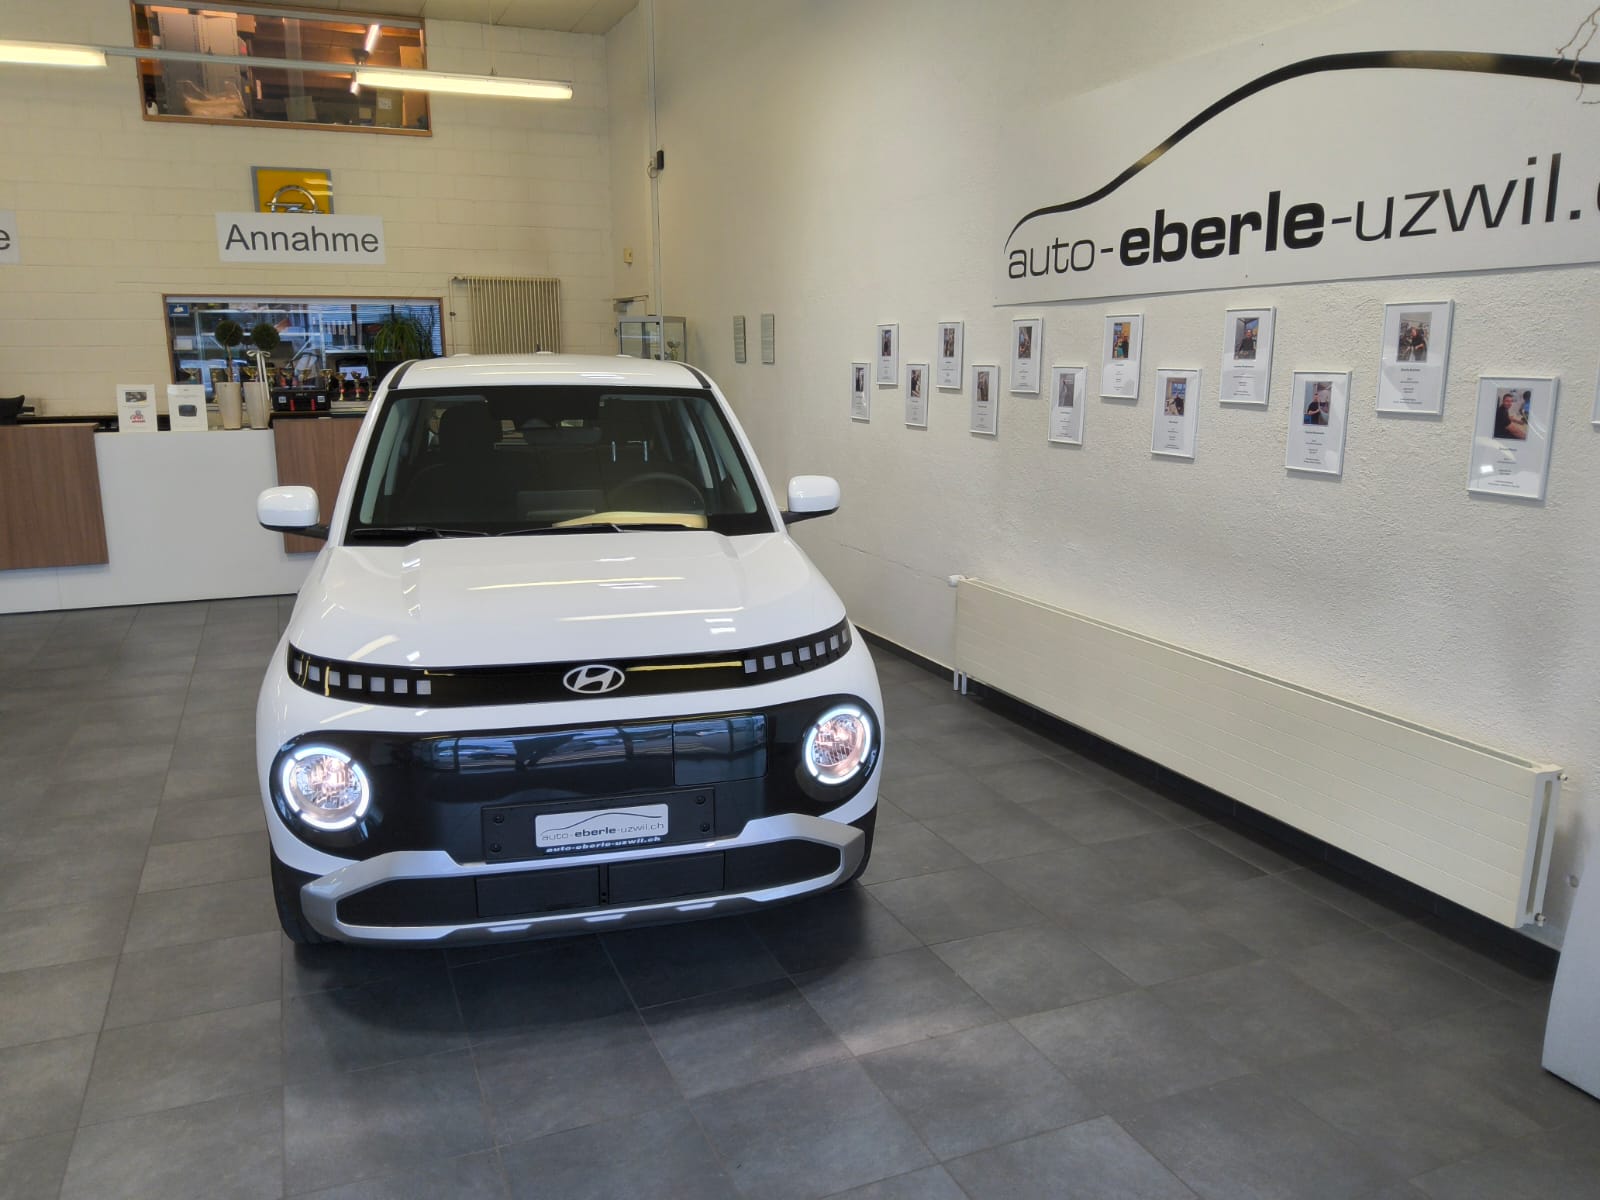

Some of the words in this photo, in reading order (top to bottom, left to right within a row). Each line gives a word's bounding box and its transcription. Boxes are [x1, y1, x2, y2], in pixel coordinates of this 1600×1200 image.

[1008, 152, 1600, 279] auto-eberle-uzwil.
[225, 223, 379, 253] Annahme
[545, 836, 662, 853] auto-eberle-uzwil.ch
